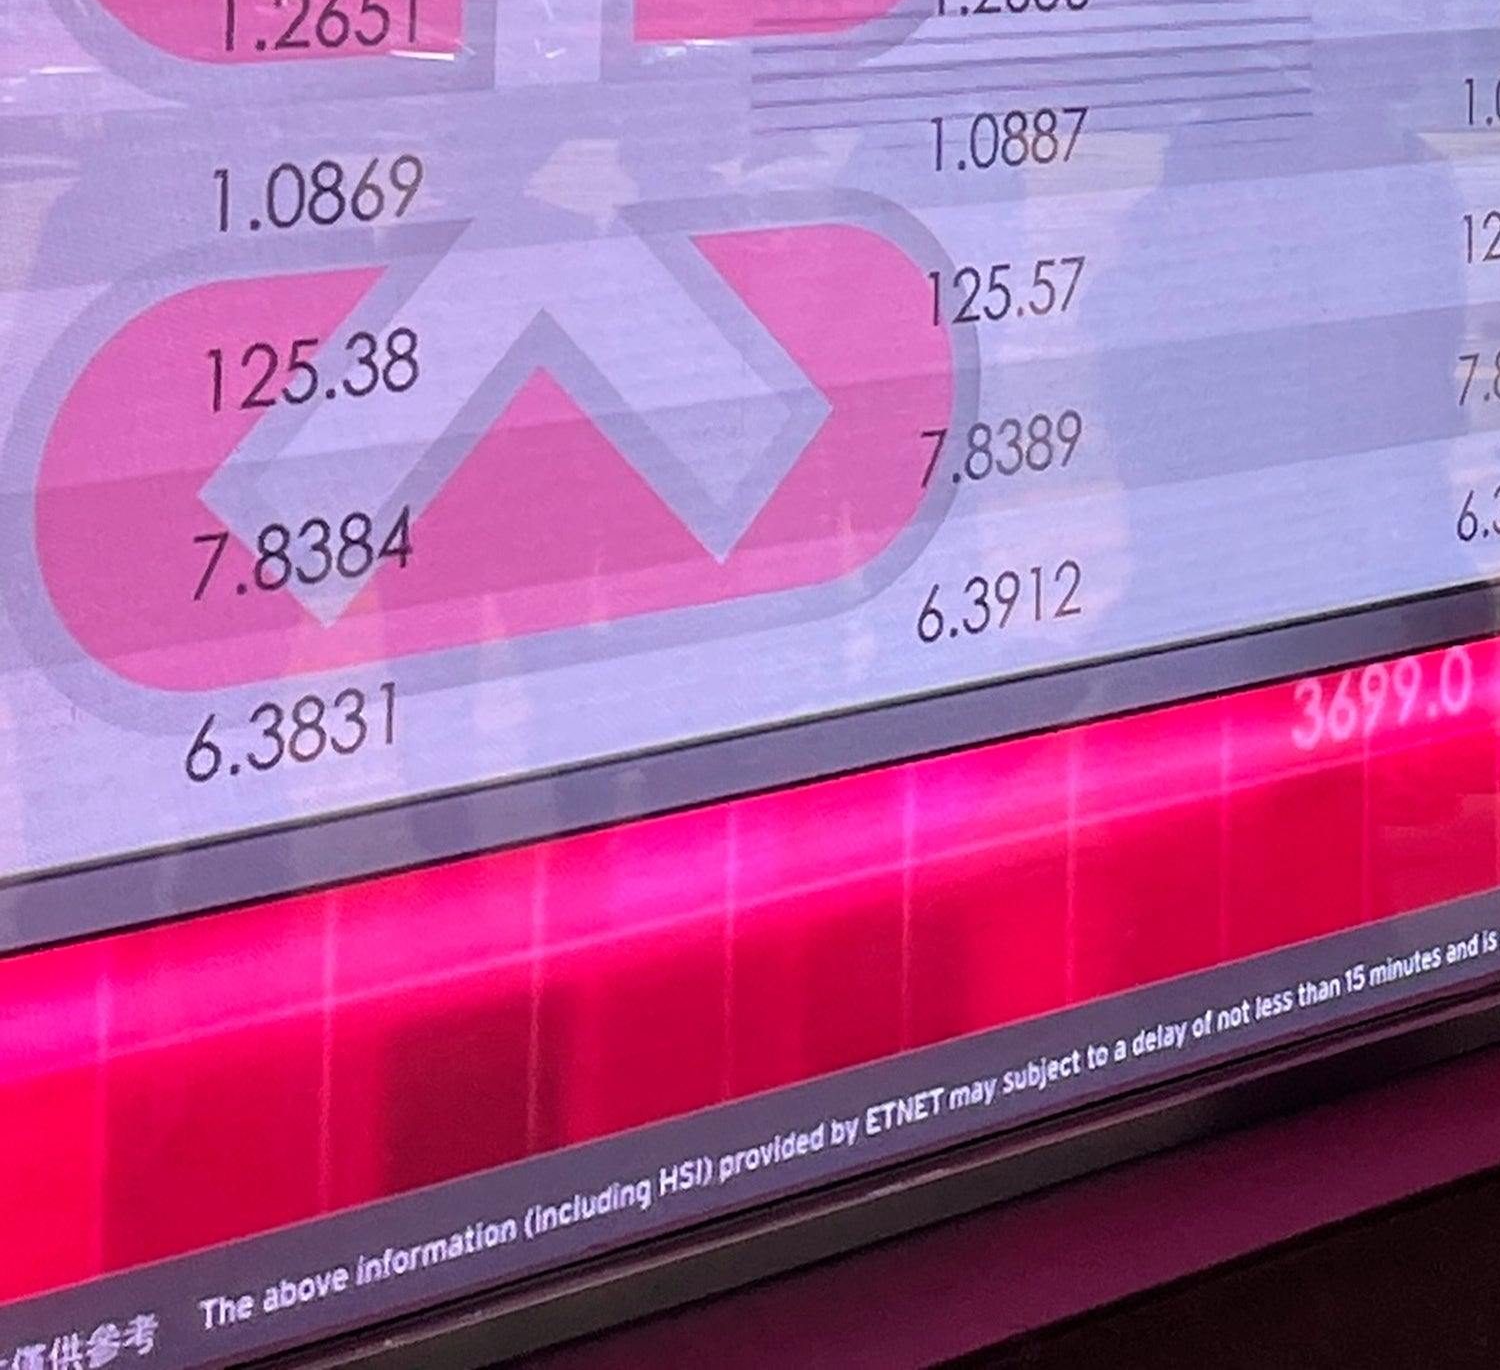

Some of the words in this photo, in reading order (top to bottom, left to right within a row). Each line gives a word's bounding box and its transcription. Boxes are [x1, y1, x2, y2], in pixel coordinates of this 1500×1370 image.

[212, 153, 425, 232] 1.0869
[930, 106, 1089, 173] 1.0887
[205, 327, 420, 414] 125.38
[927, 255, 1086, 327] 125.57
[193, 505, 414, 602] 7.8384
[920, 409, 1084, 490] 7.8389
[184, 681, 398, 784] 6.3831
[916, 558, 1084, 645] 6.3912
[1291, 647, 1474, 752] 3699.0
[199, 1294, 253, 1331] The
[262, 1267, 349, 1311] above
[355, 1222, 518, 1286] information
[525, 1179, 652, 1238] (including
[660, 1155, 712, 1195] HSI)
[719, 1128, 824, 1184] provided
[831, 1113, 860, 1150] by
[865, 1088, 946, 1136] ETNET
[949, 1077, 998, 1112] may
[1002, 1048, 1082, 1095] subject
[1087, 1044, 1109, 1067] to
[1115, 1043, 1127, 1062] a
[1132, 1021, 1187, 1058] delay
[1192, 1010, 1213, 1039] of
[1216, 1000, 1251, 1029] not
[1255, 991, 1293, 1020] less
[1298, 977, 1341, 1012] than
[1345, 968, 1366, 994] 15
[1369, 944, 1442, 987] minutes
[1446, 932, 1479, 963] and
[1483, 926, 1497, 954] is
